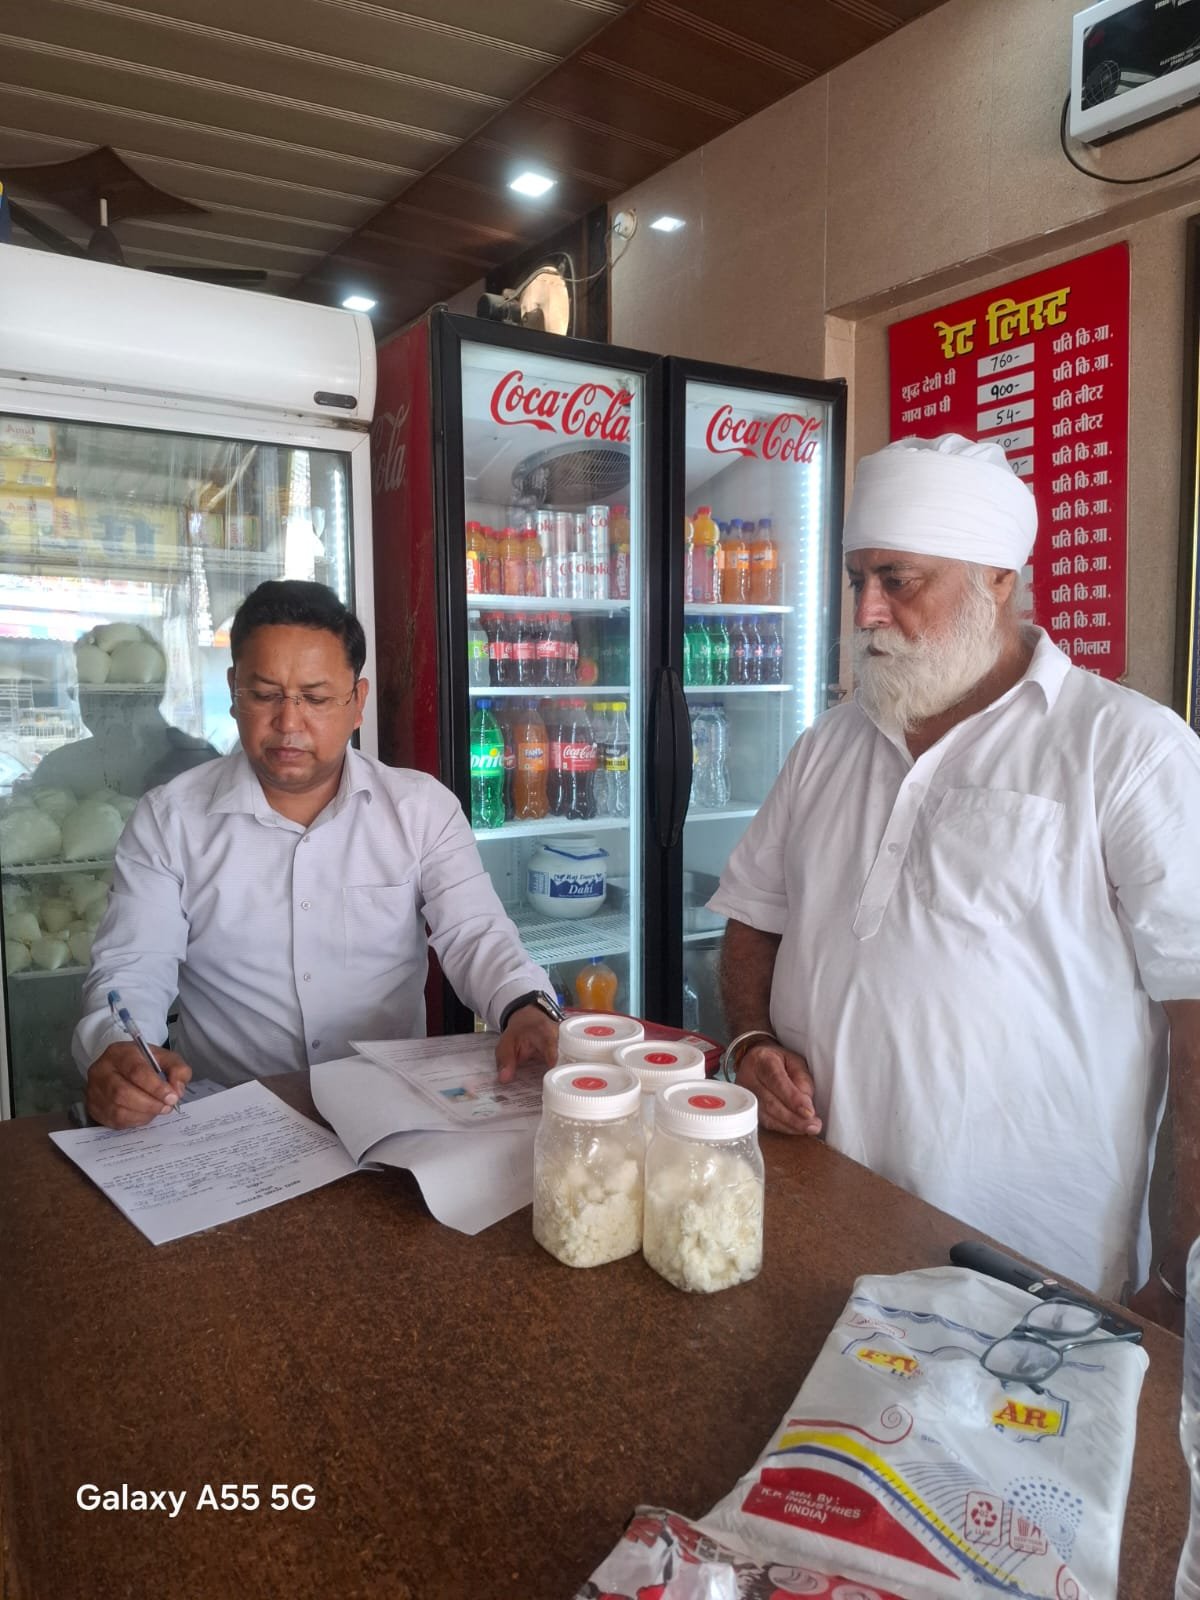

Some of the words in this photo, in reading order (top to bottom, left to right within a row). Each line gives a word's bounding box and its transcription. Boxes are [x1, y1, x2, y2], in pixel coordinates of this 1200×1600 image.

[934, 318, 977, 360] रेट
[985, 287, 1071, 346] लिस्ट
[1052, 332, 1073, 355] प्रति
[944, 367, 957, 385] घी
[1052, 361, 1073, 384] प्रति
[490, 370, 635, 442] Coca-Cola
[924, 403, 937, 417] का
[939, 395, 951, 413] घी
[1052, 390, 1073, 411] प्रति
[1075, 384, 1104, 409] लीटर
[706, 404, 822, 464] Coca-Cola
[1052, 419, 1073, 440] प्रति
[1075, 413, 1104, 438] लीटर
[1052, 445, 1072, 467] प्रति
[1052, 473, 1072, 495] प्रति
[1052, 501, 1072, 523] प्रति
[1052, 529, 1072, 550] प्रति
[1052, 556, 1072, 577] प्रति
[1051, 584, 1072, 605] प्रति
[1051, 611, 1071, 632] प्रति
[1073, 637, 1111, 657] गिलास
[568, 883, 594, 895] Dahi
[784, 1502, 828, 1524] (INDIA)
[785, 1494, 861, 1519] INDUSTRIES
